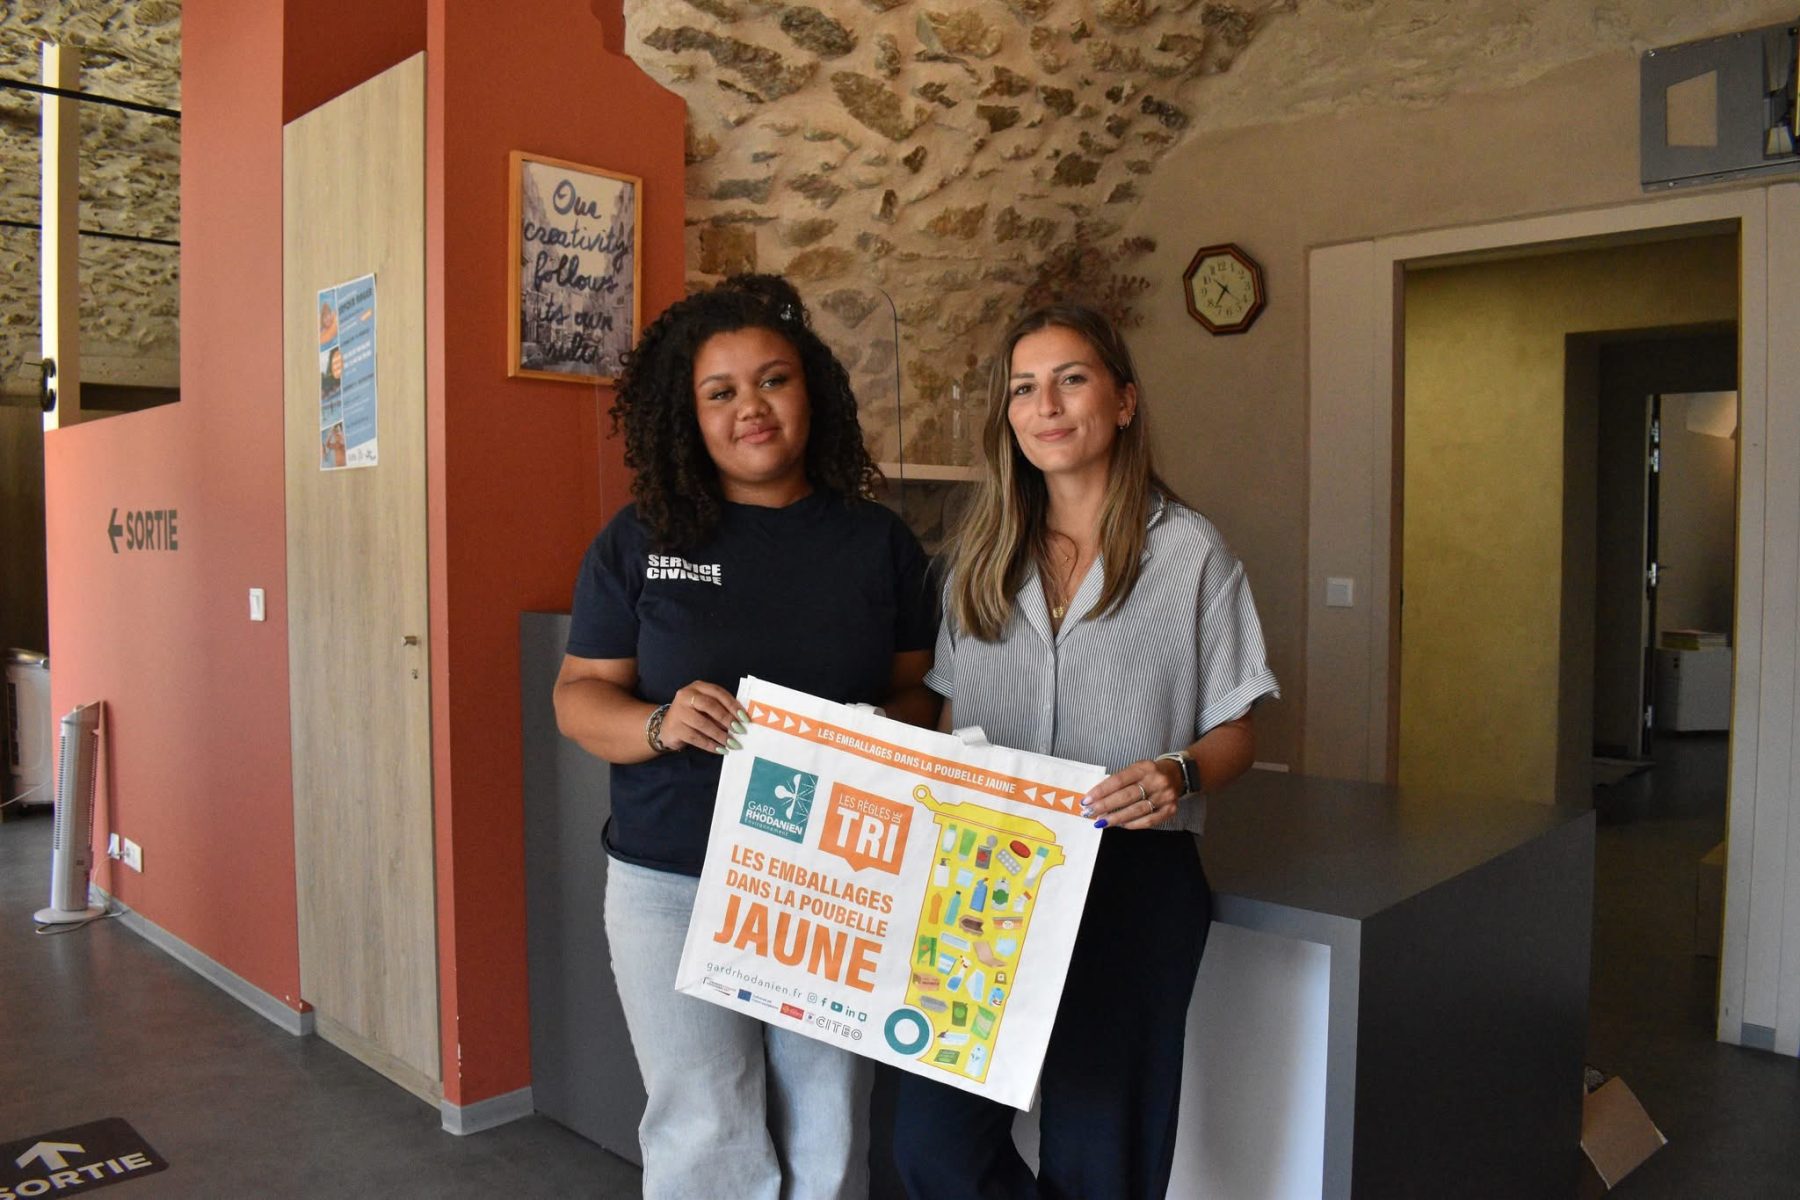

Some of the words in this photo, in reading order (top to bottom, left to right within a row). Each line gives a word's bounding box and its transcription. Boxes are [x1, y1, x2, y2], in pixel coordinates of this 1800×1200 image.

[524, 216, 630, 273] creativity
[534, 251, 619, 292] follows
[127, 509, 178, 550] SORTIE
[648, 554, 722, 576] SERVICE
[817, 727, 836, 741] LES
[835, 731, 893, 760] EMBALLAGES
[893, 752, 920, 768] DANS
[920, 760, 933, 772] LA
[934, 763, 984, 785] POUBELLE
[984, 777, 1017, 794] JAUNE
[747, 800, 776, 817] GARD
[838, 793, 855, 808] LES
[857, 797, 891, 821] RÈGLES
[837, 807, 900, 864] TRI
[731, 844, 765, 871] LES
[768, 857, 894, 914] EMBALLAGES
[725, 868, 771, 899] DANS
[774, 886, 796, 908] LA
[798, 894, 888, 938] POUBELLE
[712, 893, 883, 993] JAUNE
[706, 962, 802, 998] gardrhodanien.fr
[815, 1015, 863, 1041] CITEO
